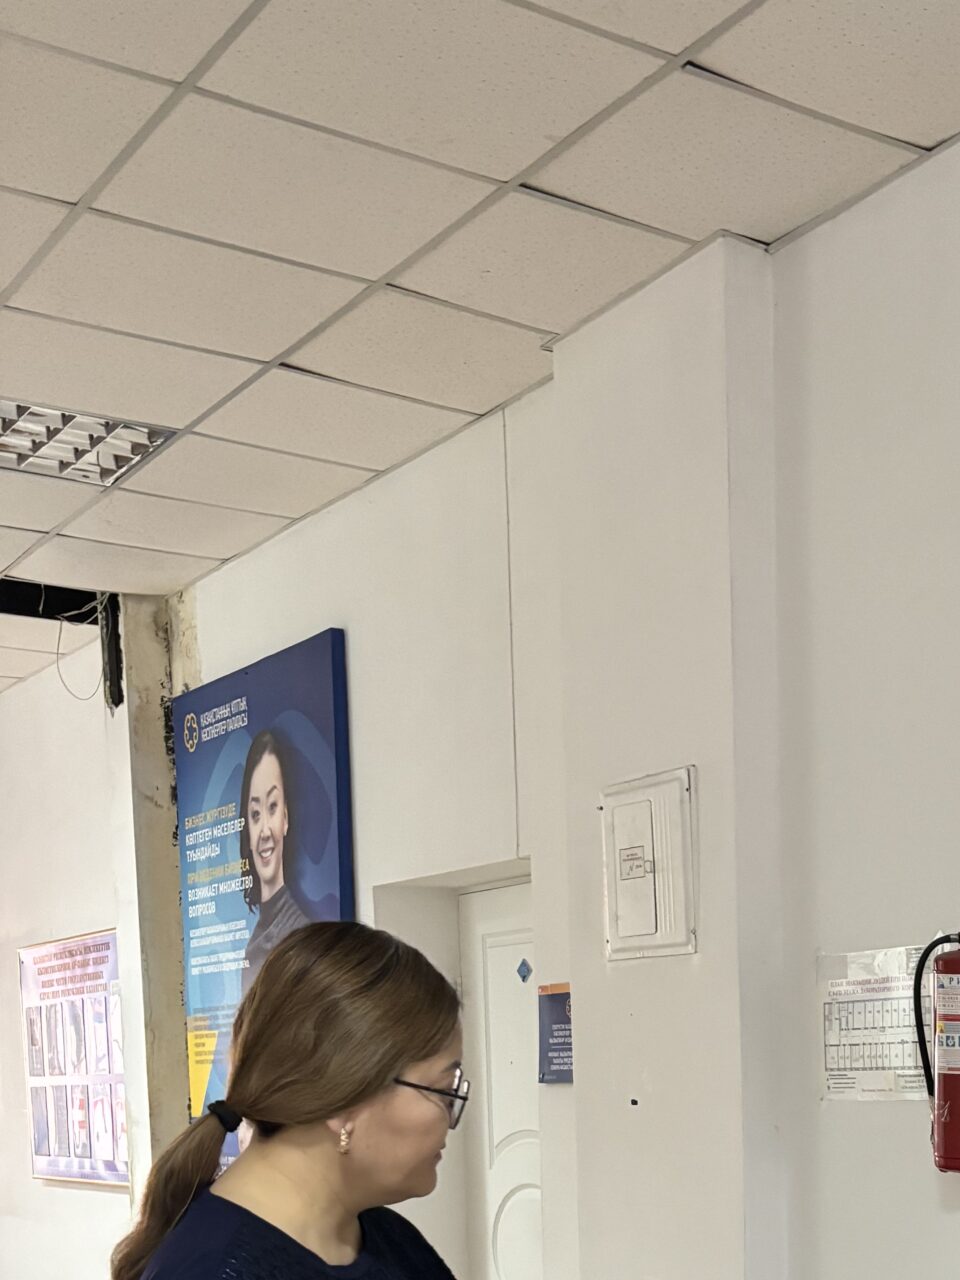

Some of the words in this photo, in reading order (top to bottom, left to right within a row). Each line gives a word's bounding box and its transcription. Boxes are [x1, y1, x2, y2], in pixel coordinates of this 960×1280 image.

[188, 883, 218, 902] ВОЗНИКАЕТ
[218, 875, 253, 895] МНОЖЕСТВО
[188, 901, 216, 918] ВОПРОСОВ
